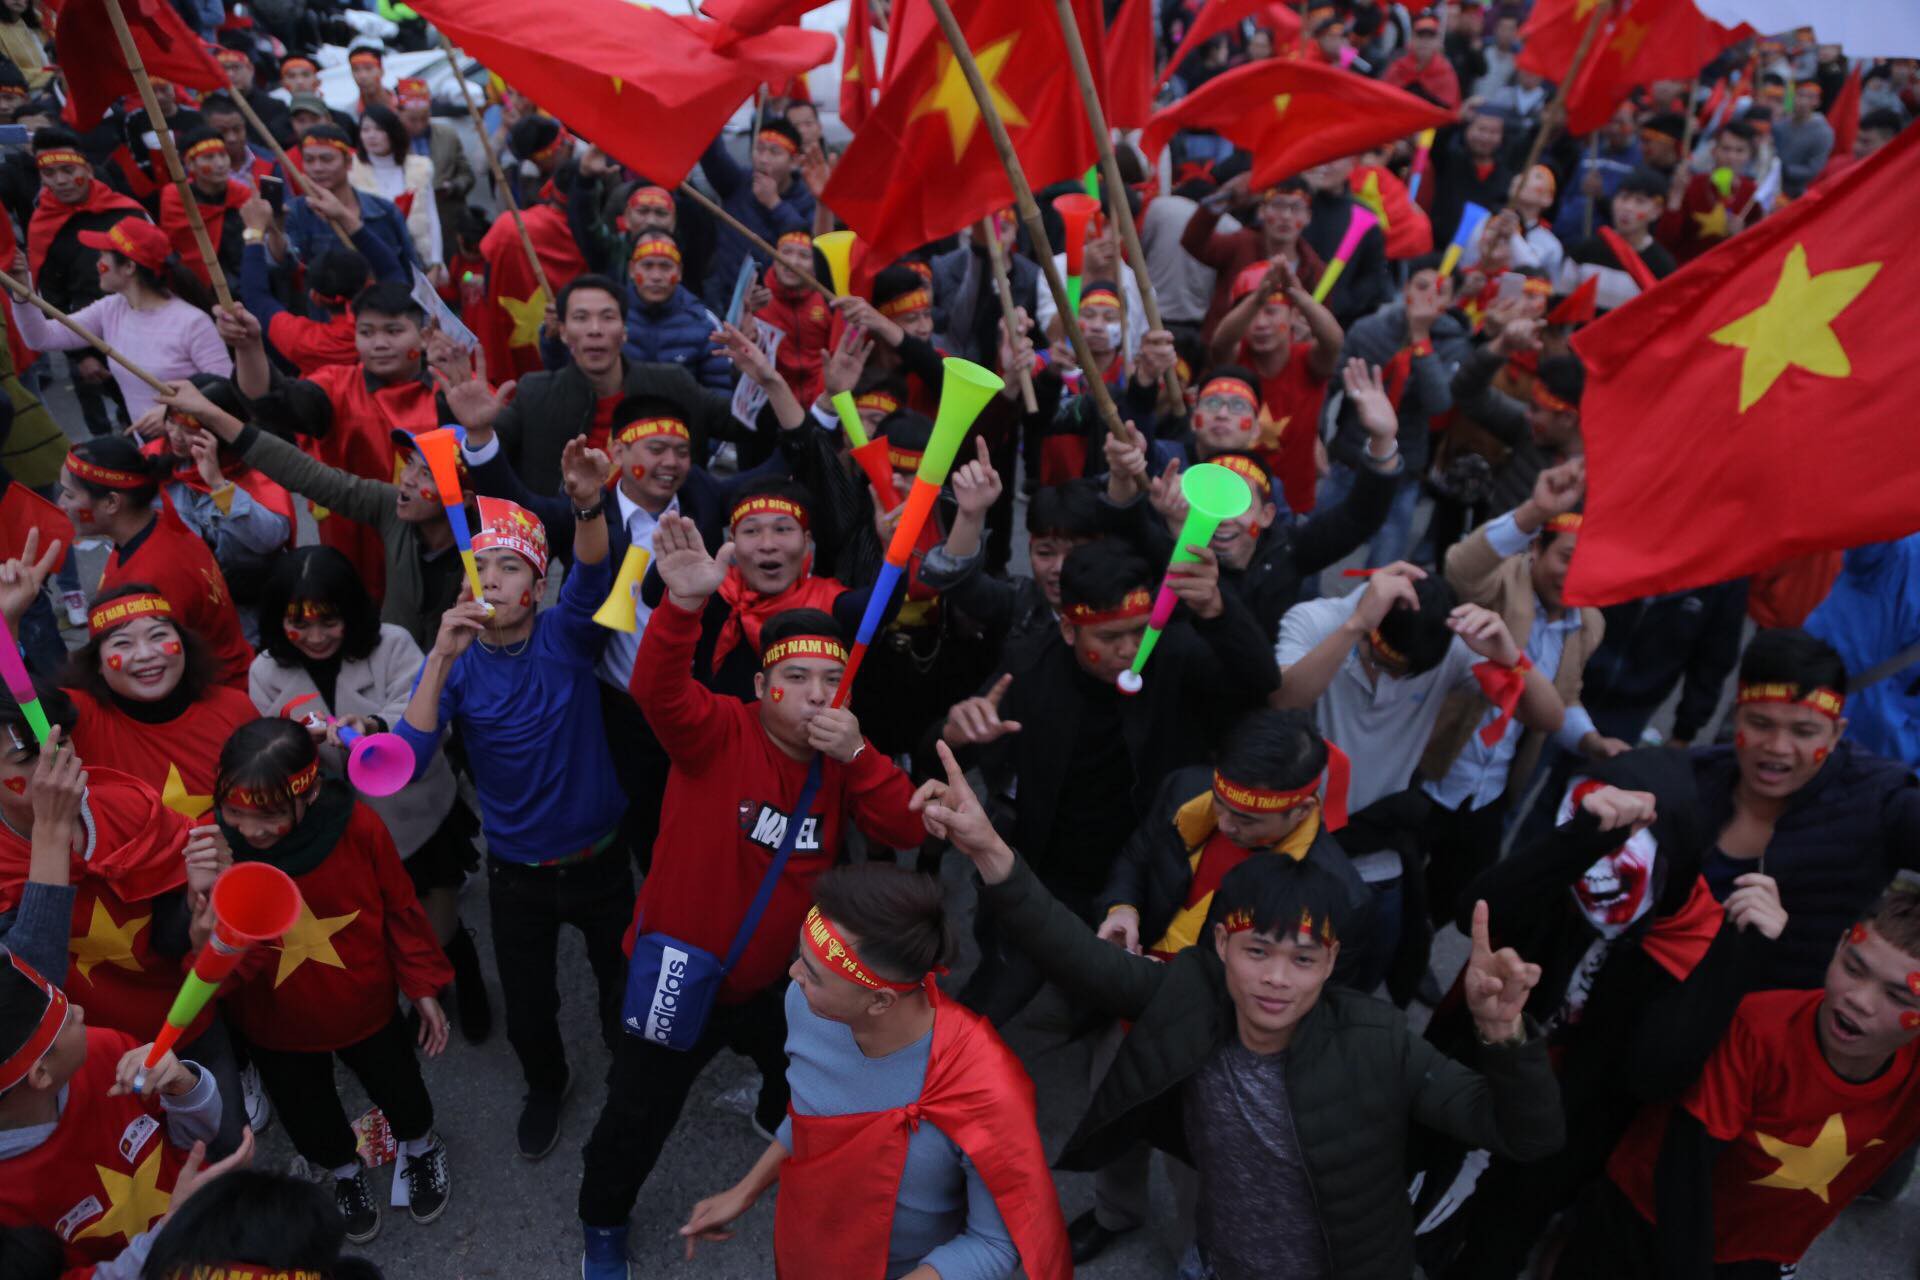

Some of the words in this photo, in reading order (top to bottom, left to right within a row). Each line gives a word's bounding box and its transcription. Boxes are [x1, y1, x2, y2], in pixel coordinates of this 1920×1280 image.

[752, 498, 766, 509] VÔ
[105, 604, 126, 621] NAM
[126, 595, 155, 614] CHIẾN
[765, 643, 786, 664] VIỆT
[787, 639, 822, 654] NAM
[823, 641, 841, 658] VÔ
[1226, 786, 1256, 807] CHIẾN
[809, 917, 831, 948] NAM
[841, 957, 858, 973] VÔ
[653, 959, 688, 1044] adidas
